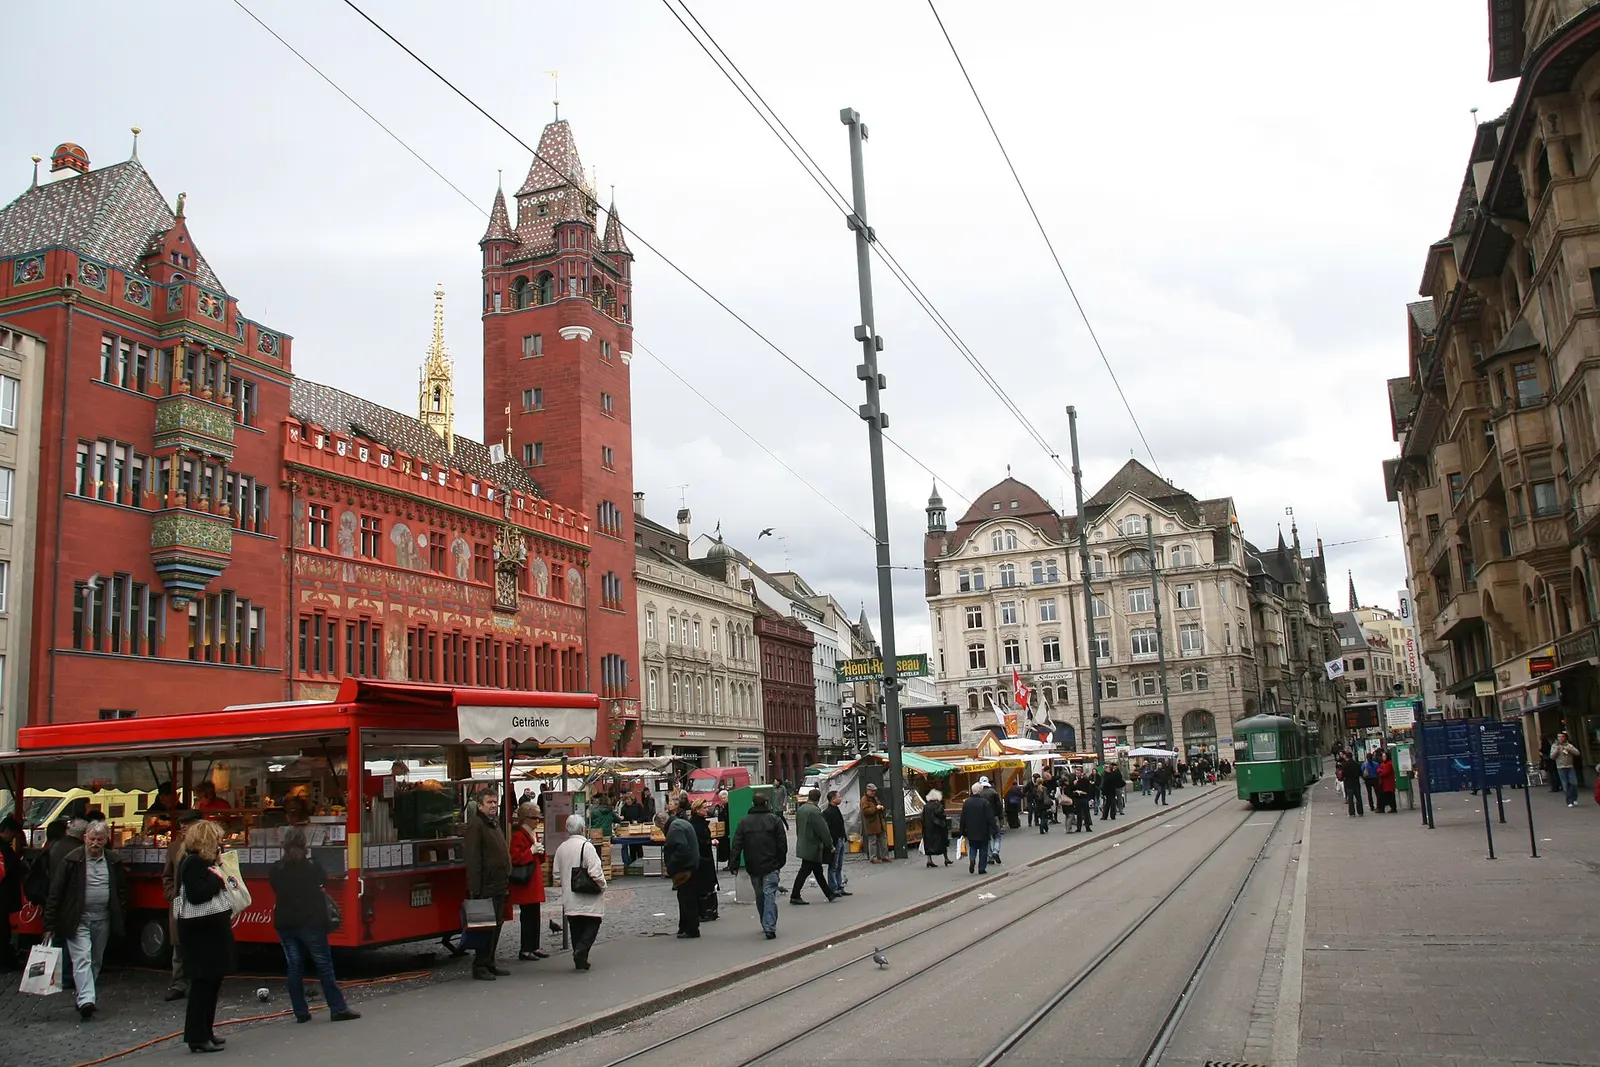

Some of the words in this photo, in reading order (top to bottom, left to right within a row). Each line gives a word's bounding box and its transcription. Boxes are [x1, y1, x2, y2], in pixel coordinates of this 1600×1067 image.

[844, 660, 870, 676] Henri
[872, 658, 920, 674] Roseau
[512, 716, 550, 728] Getränke
[843, 709, 853, 747] PKZ
[858, 716, 868, 751] PKZ
[1260, 734, 1268, 742] 14
